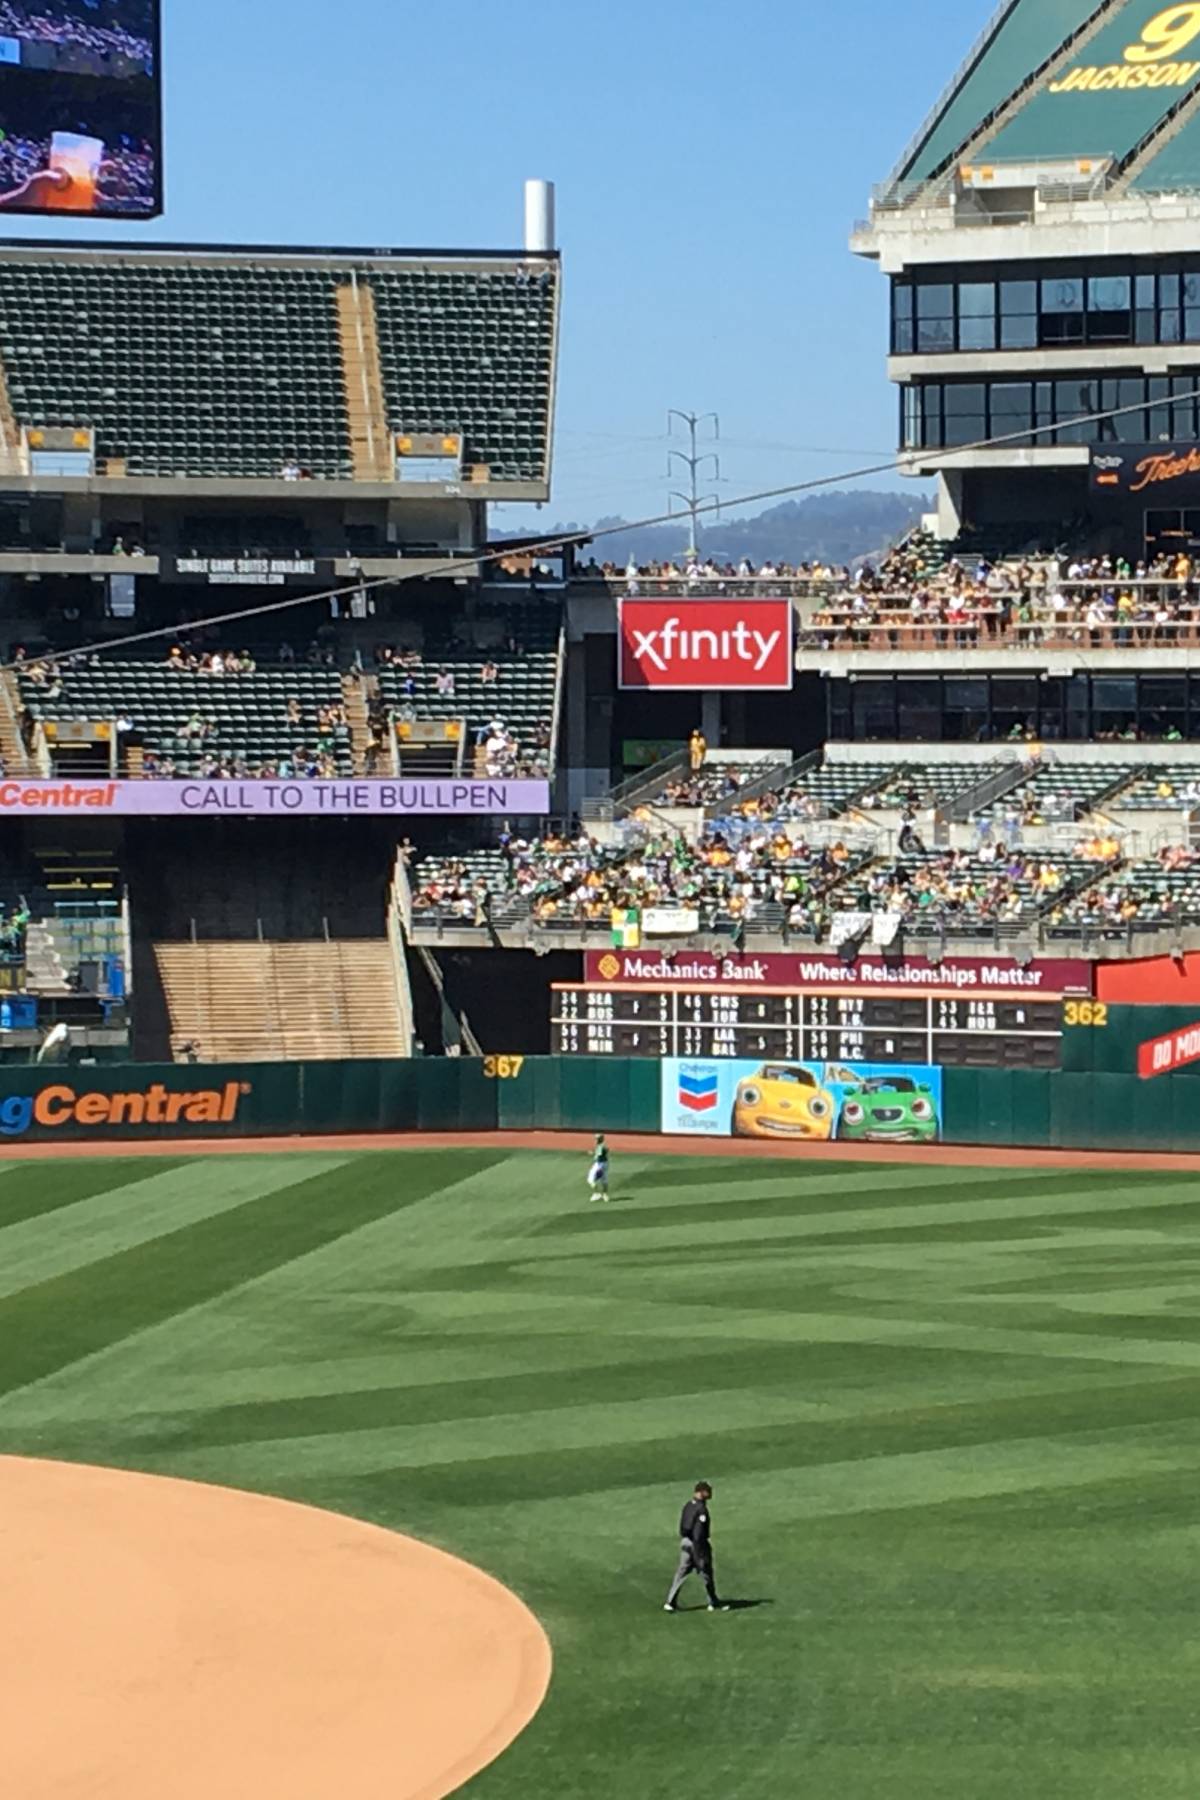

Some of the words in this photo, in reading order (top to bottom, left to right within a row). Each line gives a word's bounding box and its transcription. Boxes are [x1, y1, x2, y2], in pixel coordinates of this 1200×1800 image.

[176, 558, 209, 573] SINGLE
[210, 559, 236, 573] GAME
[271, 559, 316, 574] AVAILABLE
[632, 617, 781, 671] xfinity
[0, 783, 116, 808] Central
[180, 786, 254, 808] CALL
[266, 786, 303, 808] TO
[313, 786, 369, 808] THE
[379, 786, 508, 808] BULLPEN
[623, 957, 717, 979] Mechanics
[722, 958, 766, 980] Bank
[800, 962, 857, 981] Where
[861, 963, 977, 987] Relationships
[981, 966, 1042, 986] Matter
[586, 992, 613, 1005] SEA
[837, 998, 863, 1012] NYY
[587, 1007, 613, 1020] BOS
[969, 1001, 994, 1015] TEX
[1064, 1002, 1107, 1026] 362
[712, 1010, 738, 1023] TOR
[967, 1016, 996, 1030] HOU
[587, 1025, 612, 1038] DET
[713, 1028, 735, 1041] LAA
[839, 1031, 863, 1045] PHI
[588, 1039, 614, 1053] MIN
[712, 1042, 737, 1056] BAL
[1152, 1041, 1172, 1070] DO
[484, 1055, 524, 1079] 367
